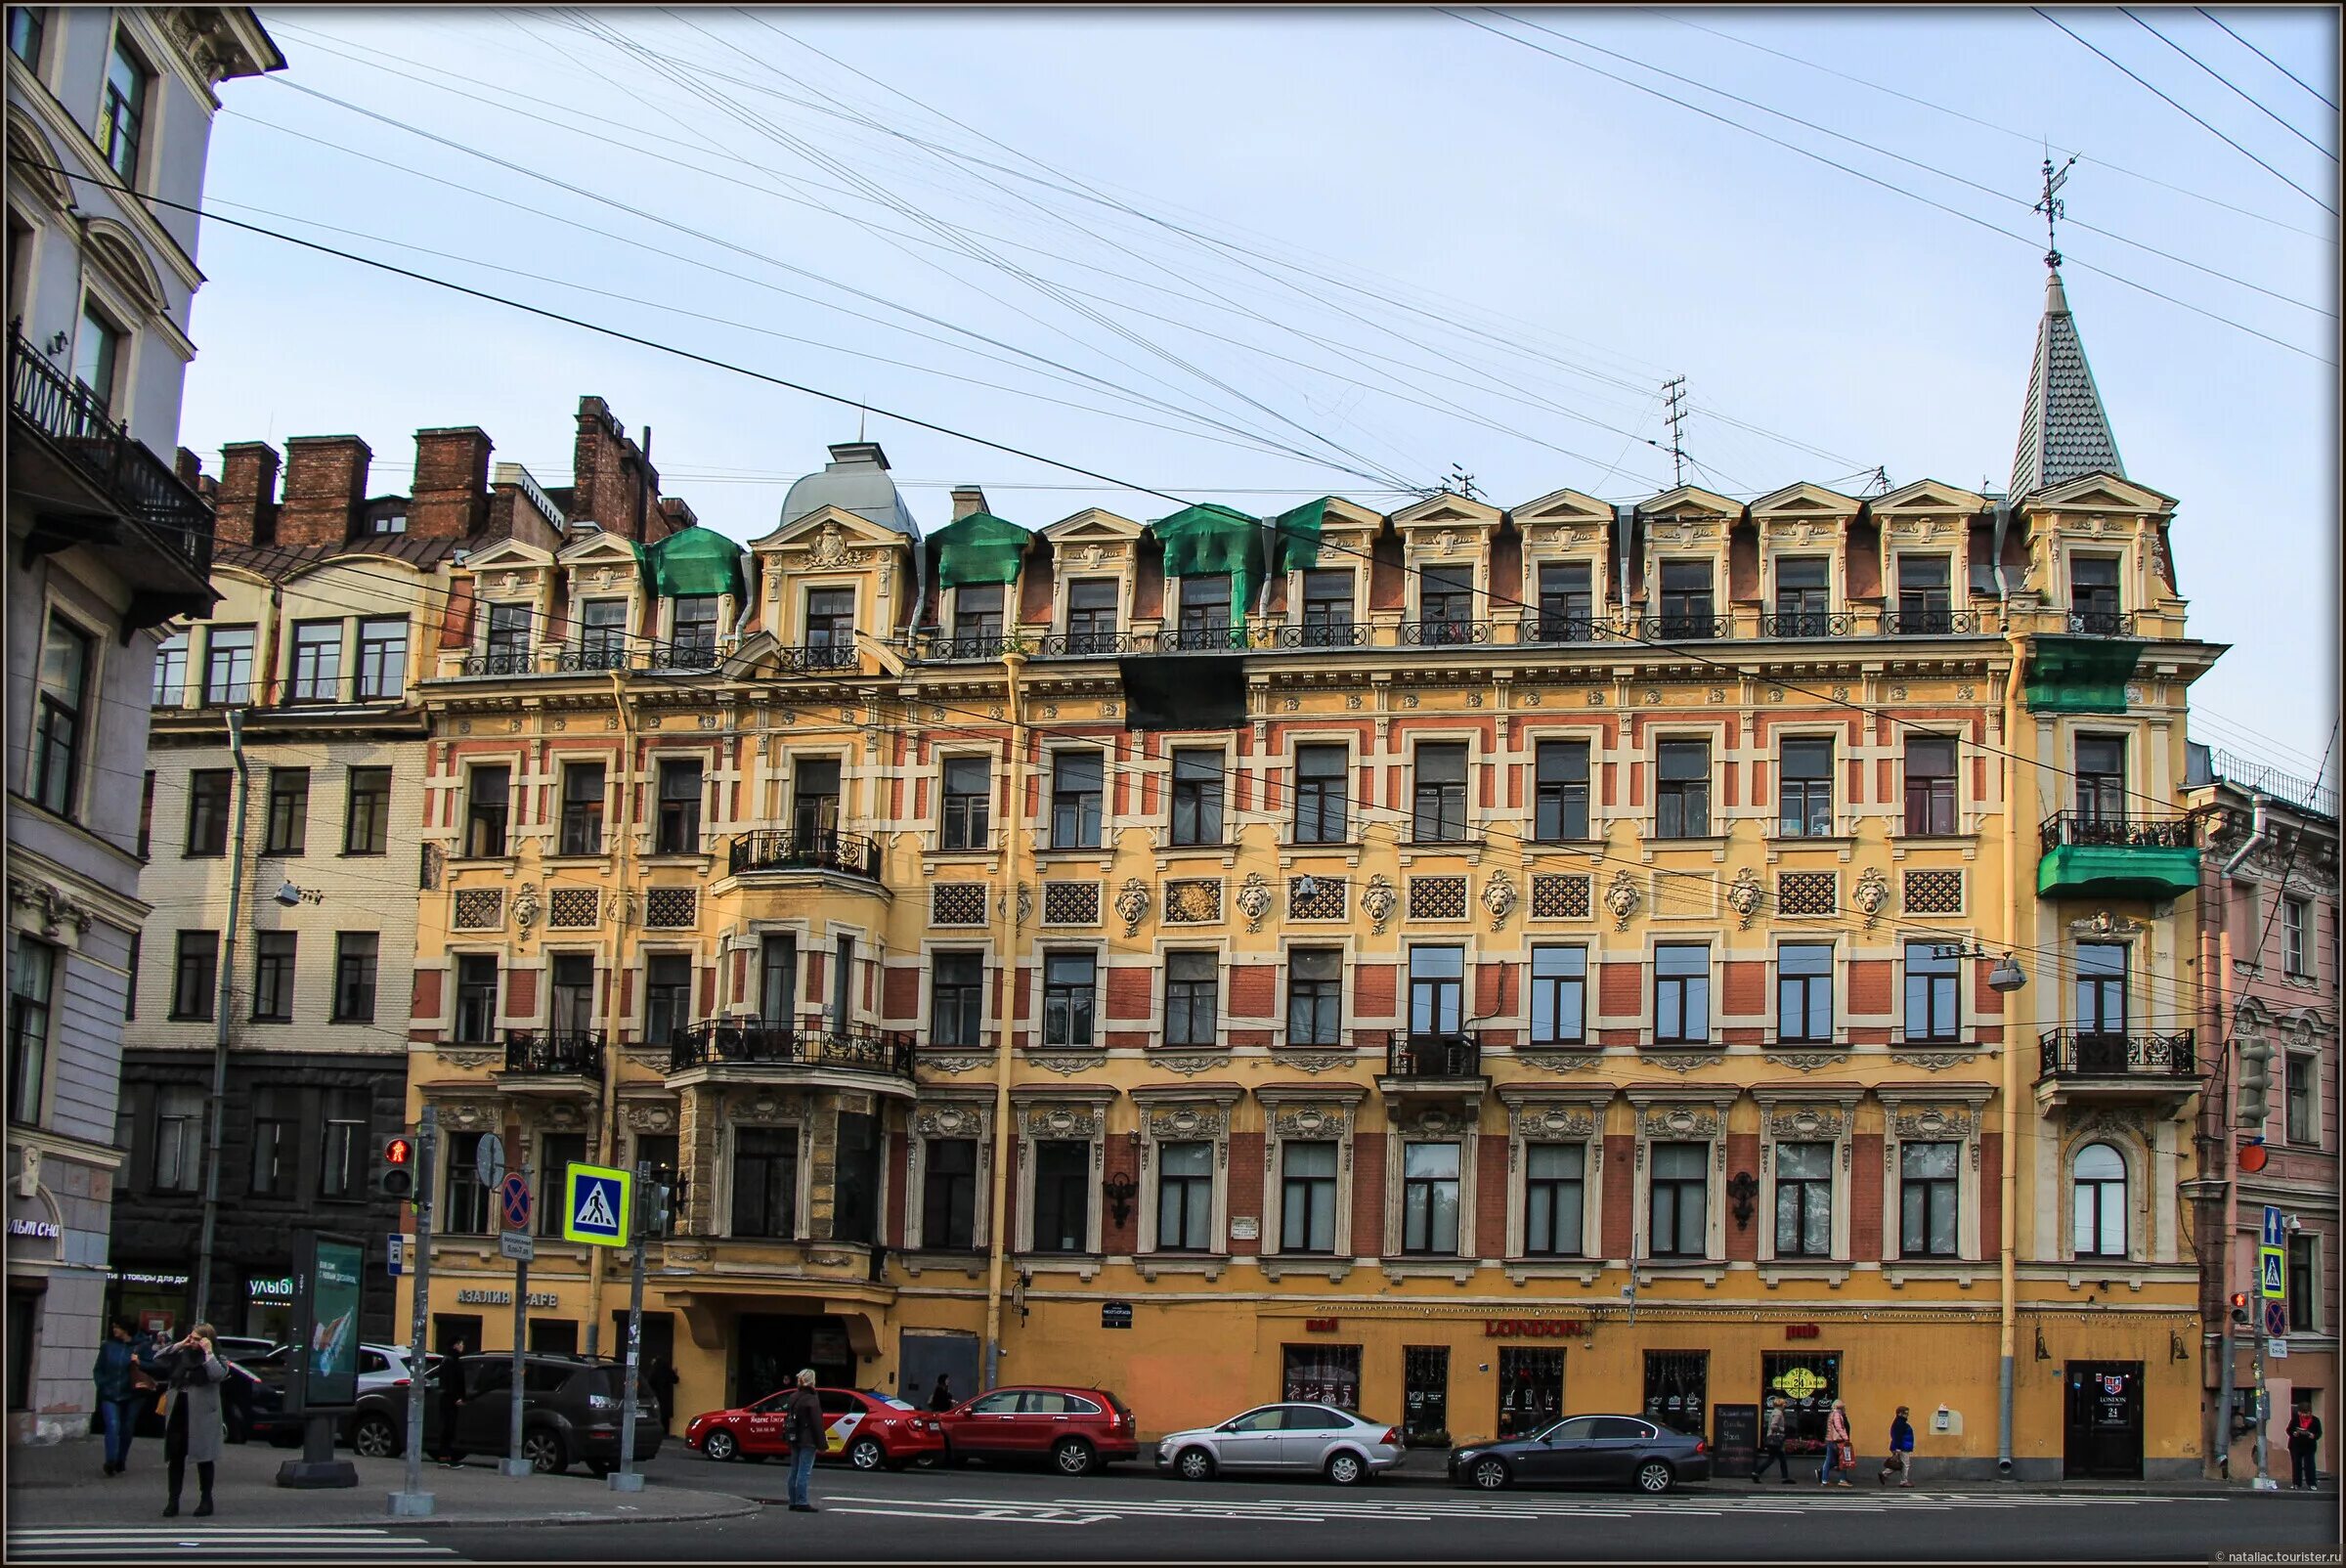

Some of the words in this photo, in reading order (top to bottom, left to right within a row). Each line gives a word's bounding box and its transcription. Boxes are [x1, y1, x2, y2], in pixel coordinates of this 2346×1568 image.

[456, 1289, 511, 1305] АЗАЛИЯ
[1485, 1320, 1583, 1338] LONDON
[1794, 1379, 1804, 1388] 24
